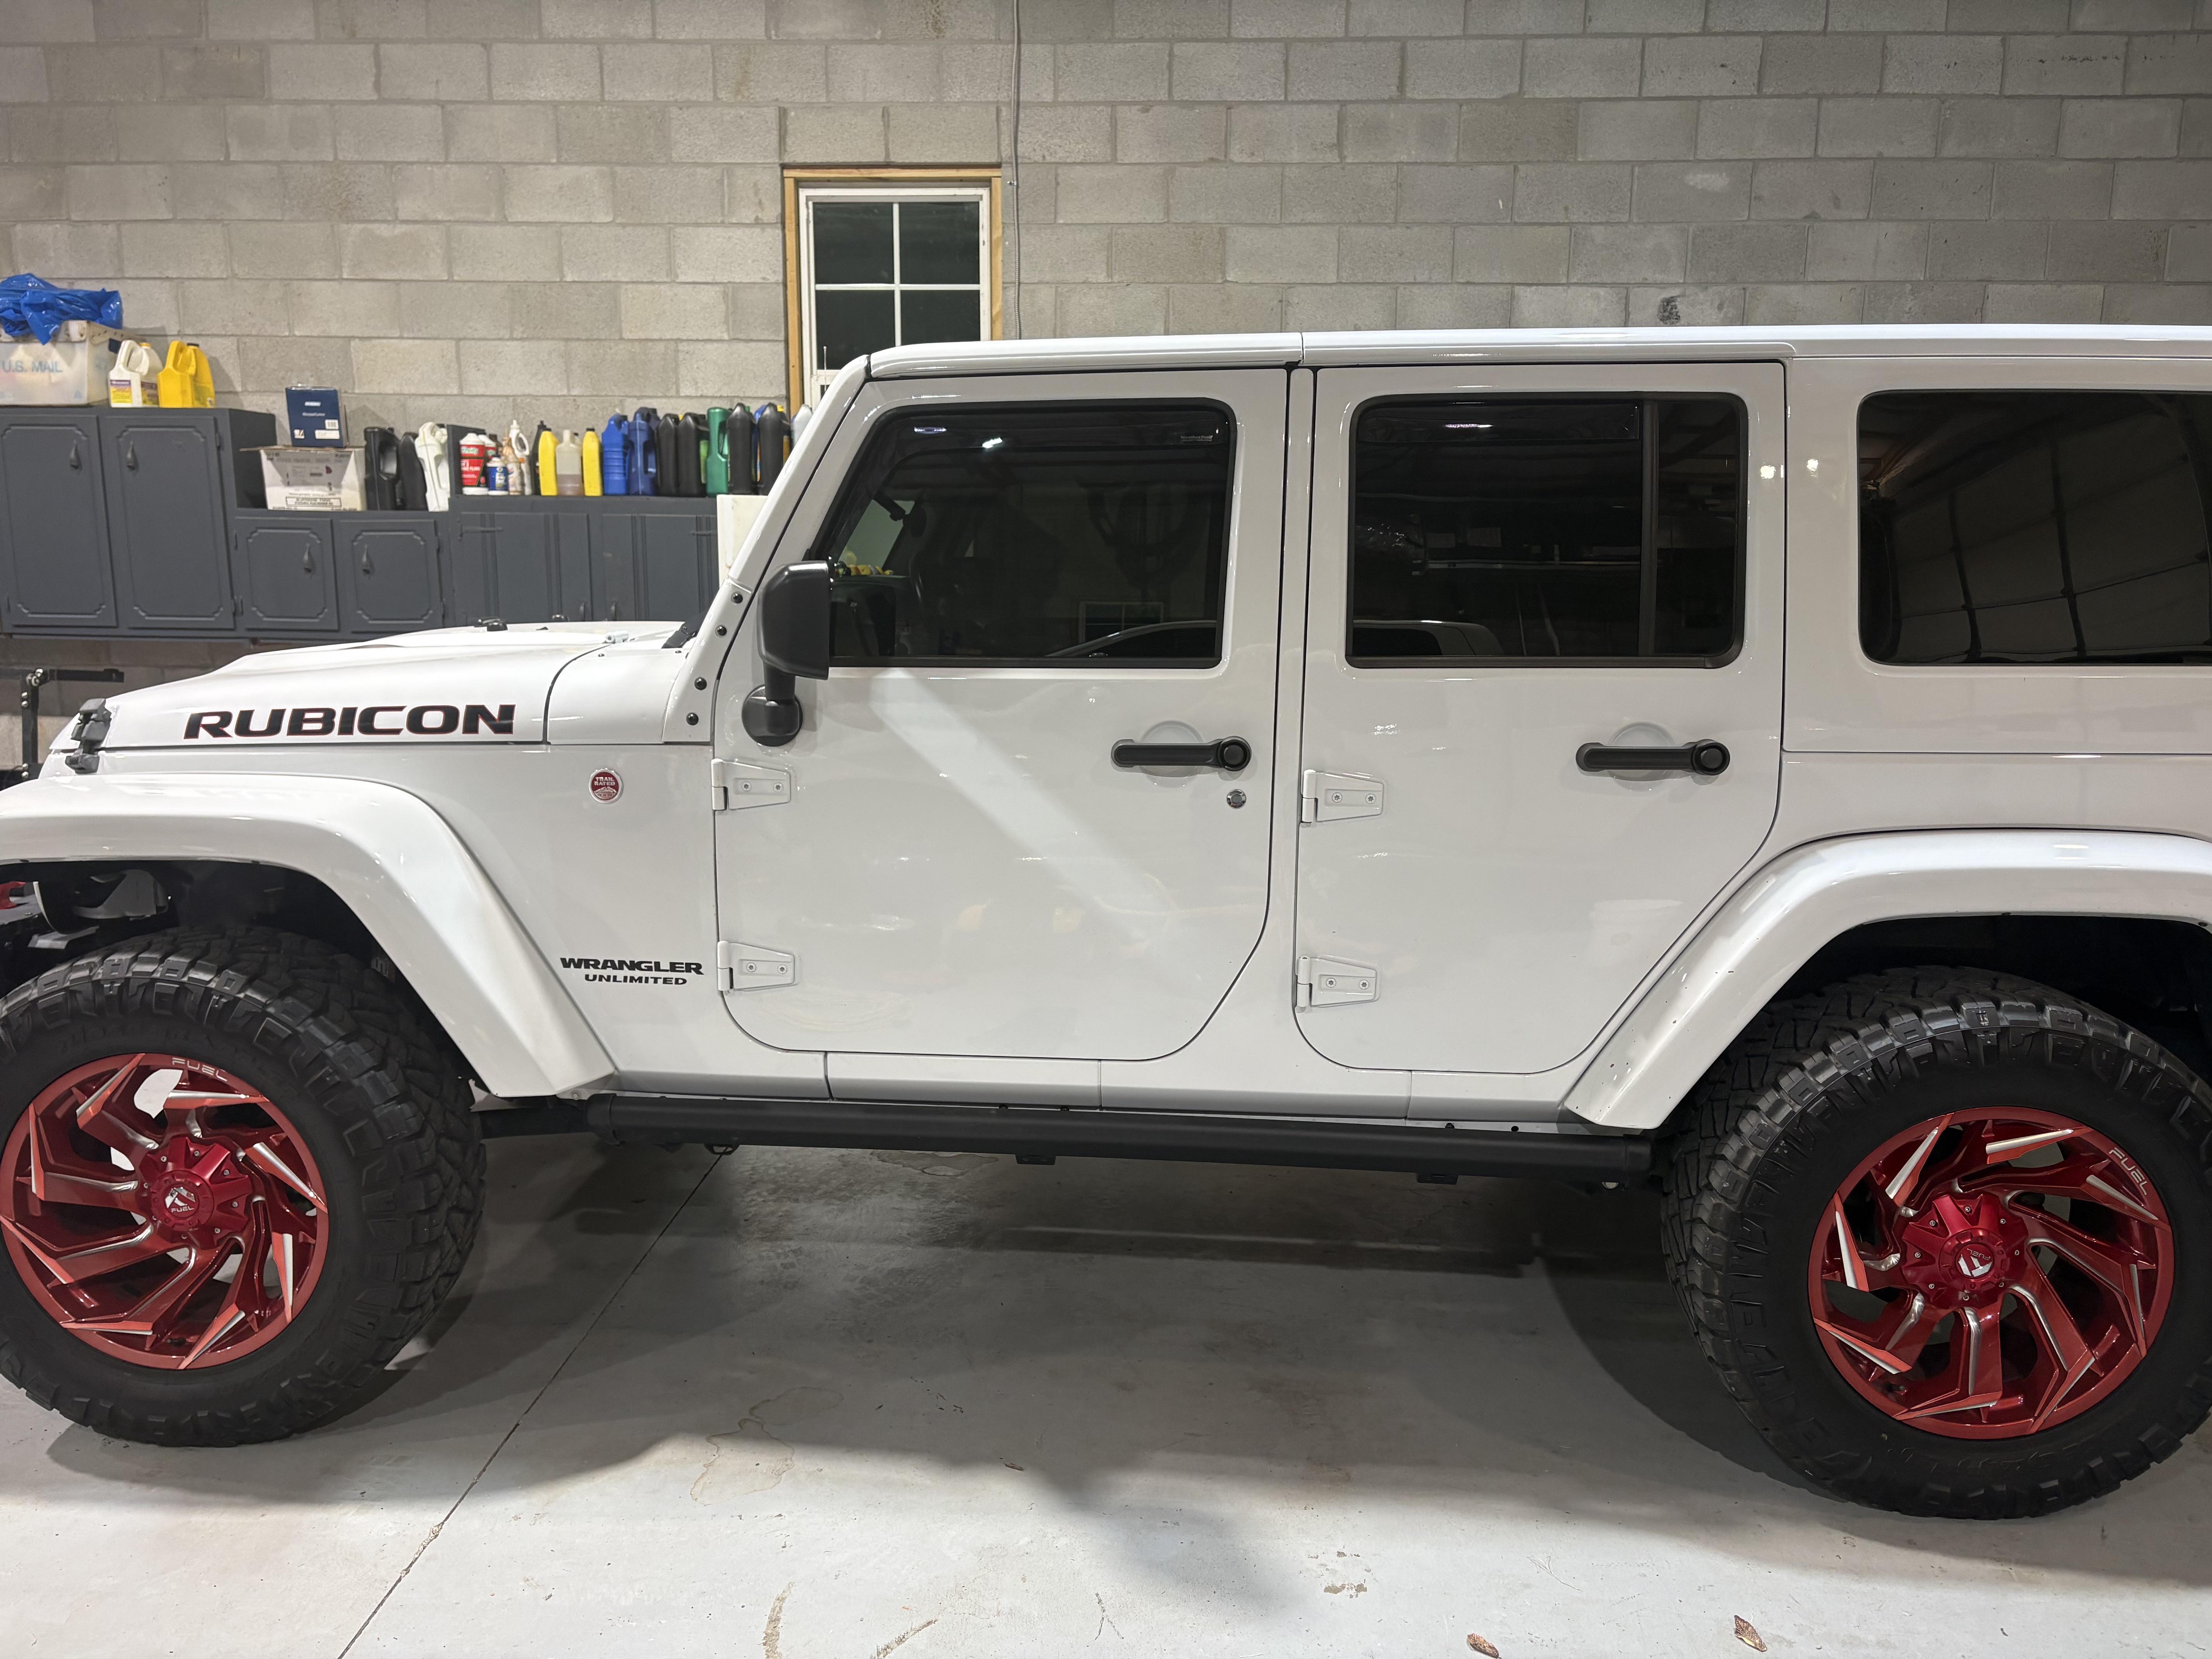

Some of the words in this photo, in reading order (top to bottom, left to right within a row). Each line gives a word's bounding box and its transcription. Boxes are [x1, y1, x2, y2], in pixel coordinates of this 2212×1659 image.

[1, 360, 27, 372] U.S.
[31, 361, 62, 373] MAIL
[184, 704, 516, 739] RUBICON
[560, 957, 704, 975] WRANGLER
[584, 974, 687, 985] UNLIMITED
[172, 1057, 227, 1082] FUEL
[2109, 1147, 2147, 1195] FUEL
[1967, 1248, 1990, 1261] FUEL
